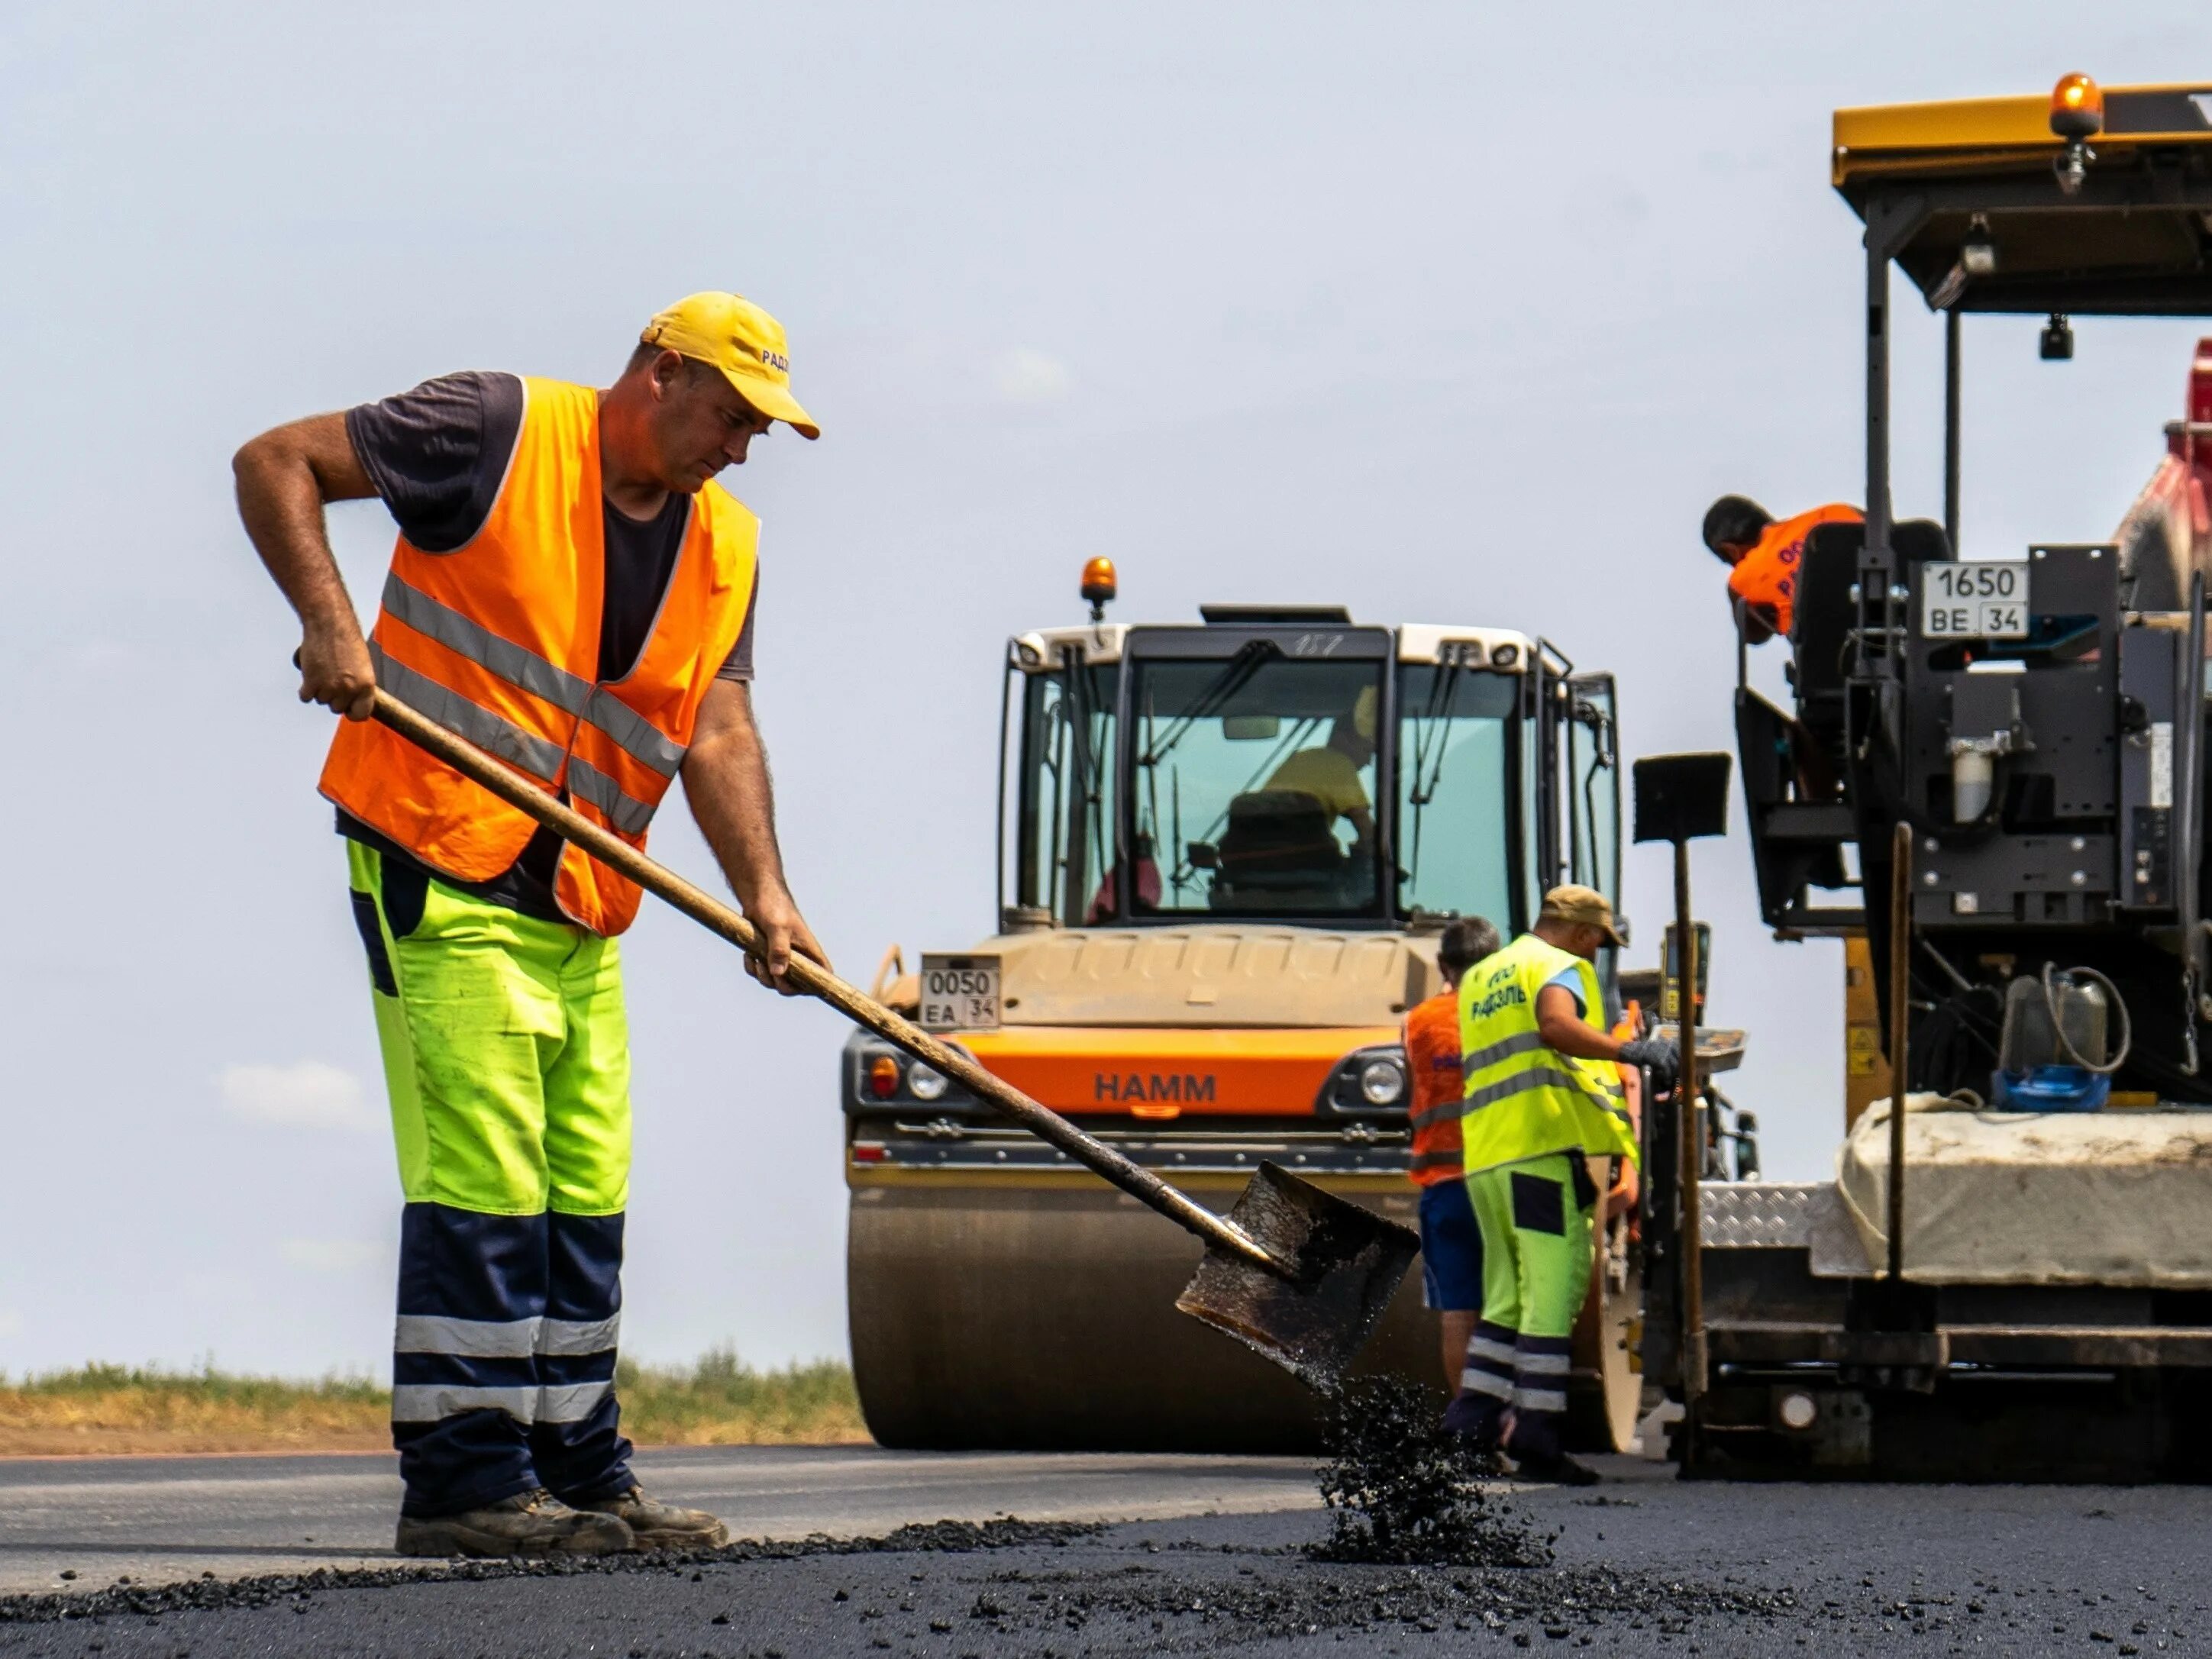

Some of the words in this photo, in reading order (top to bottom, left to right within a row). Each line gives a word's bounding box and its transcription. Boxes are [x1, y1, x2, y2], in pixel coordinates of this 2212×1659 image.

[1938, 567, 2014, 596] 1650
[1989, 608, 2019, 631] 34
[930, 971, 990, 995] 0050
[970, 999, 993, 1018] 34
[1095, 1073, 1216, 1101] HAMM
